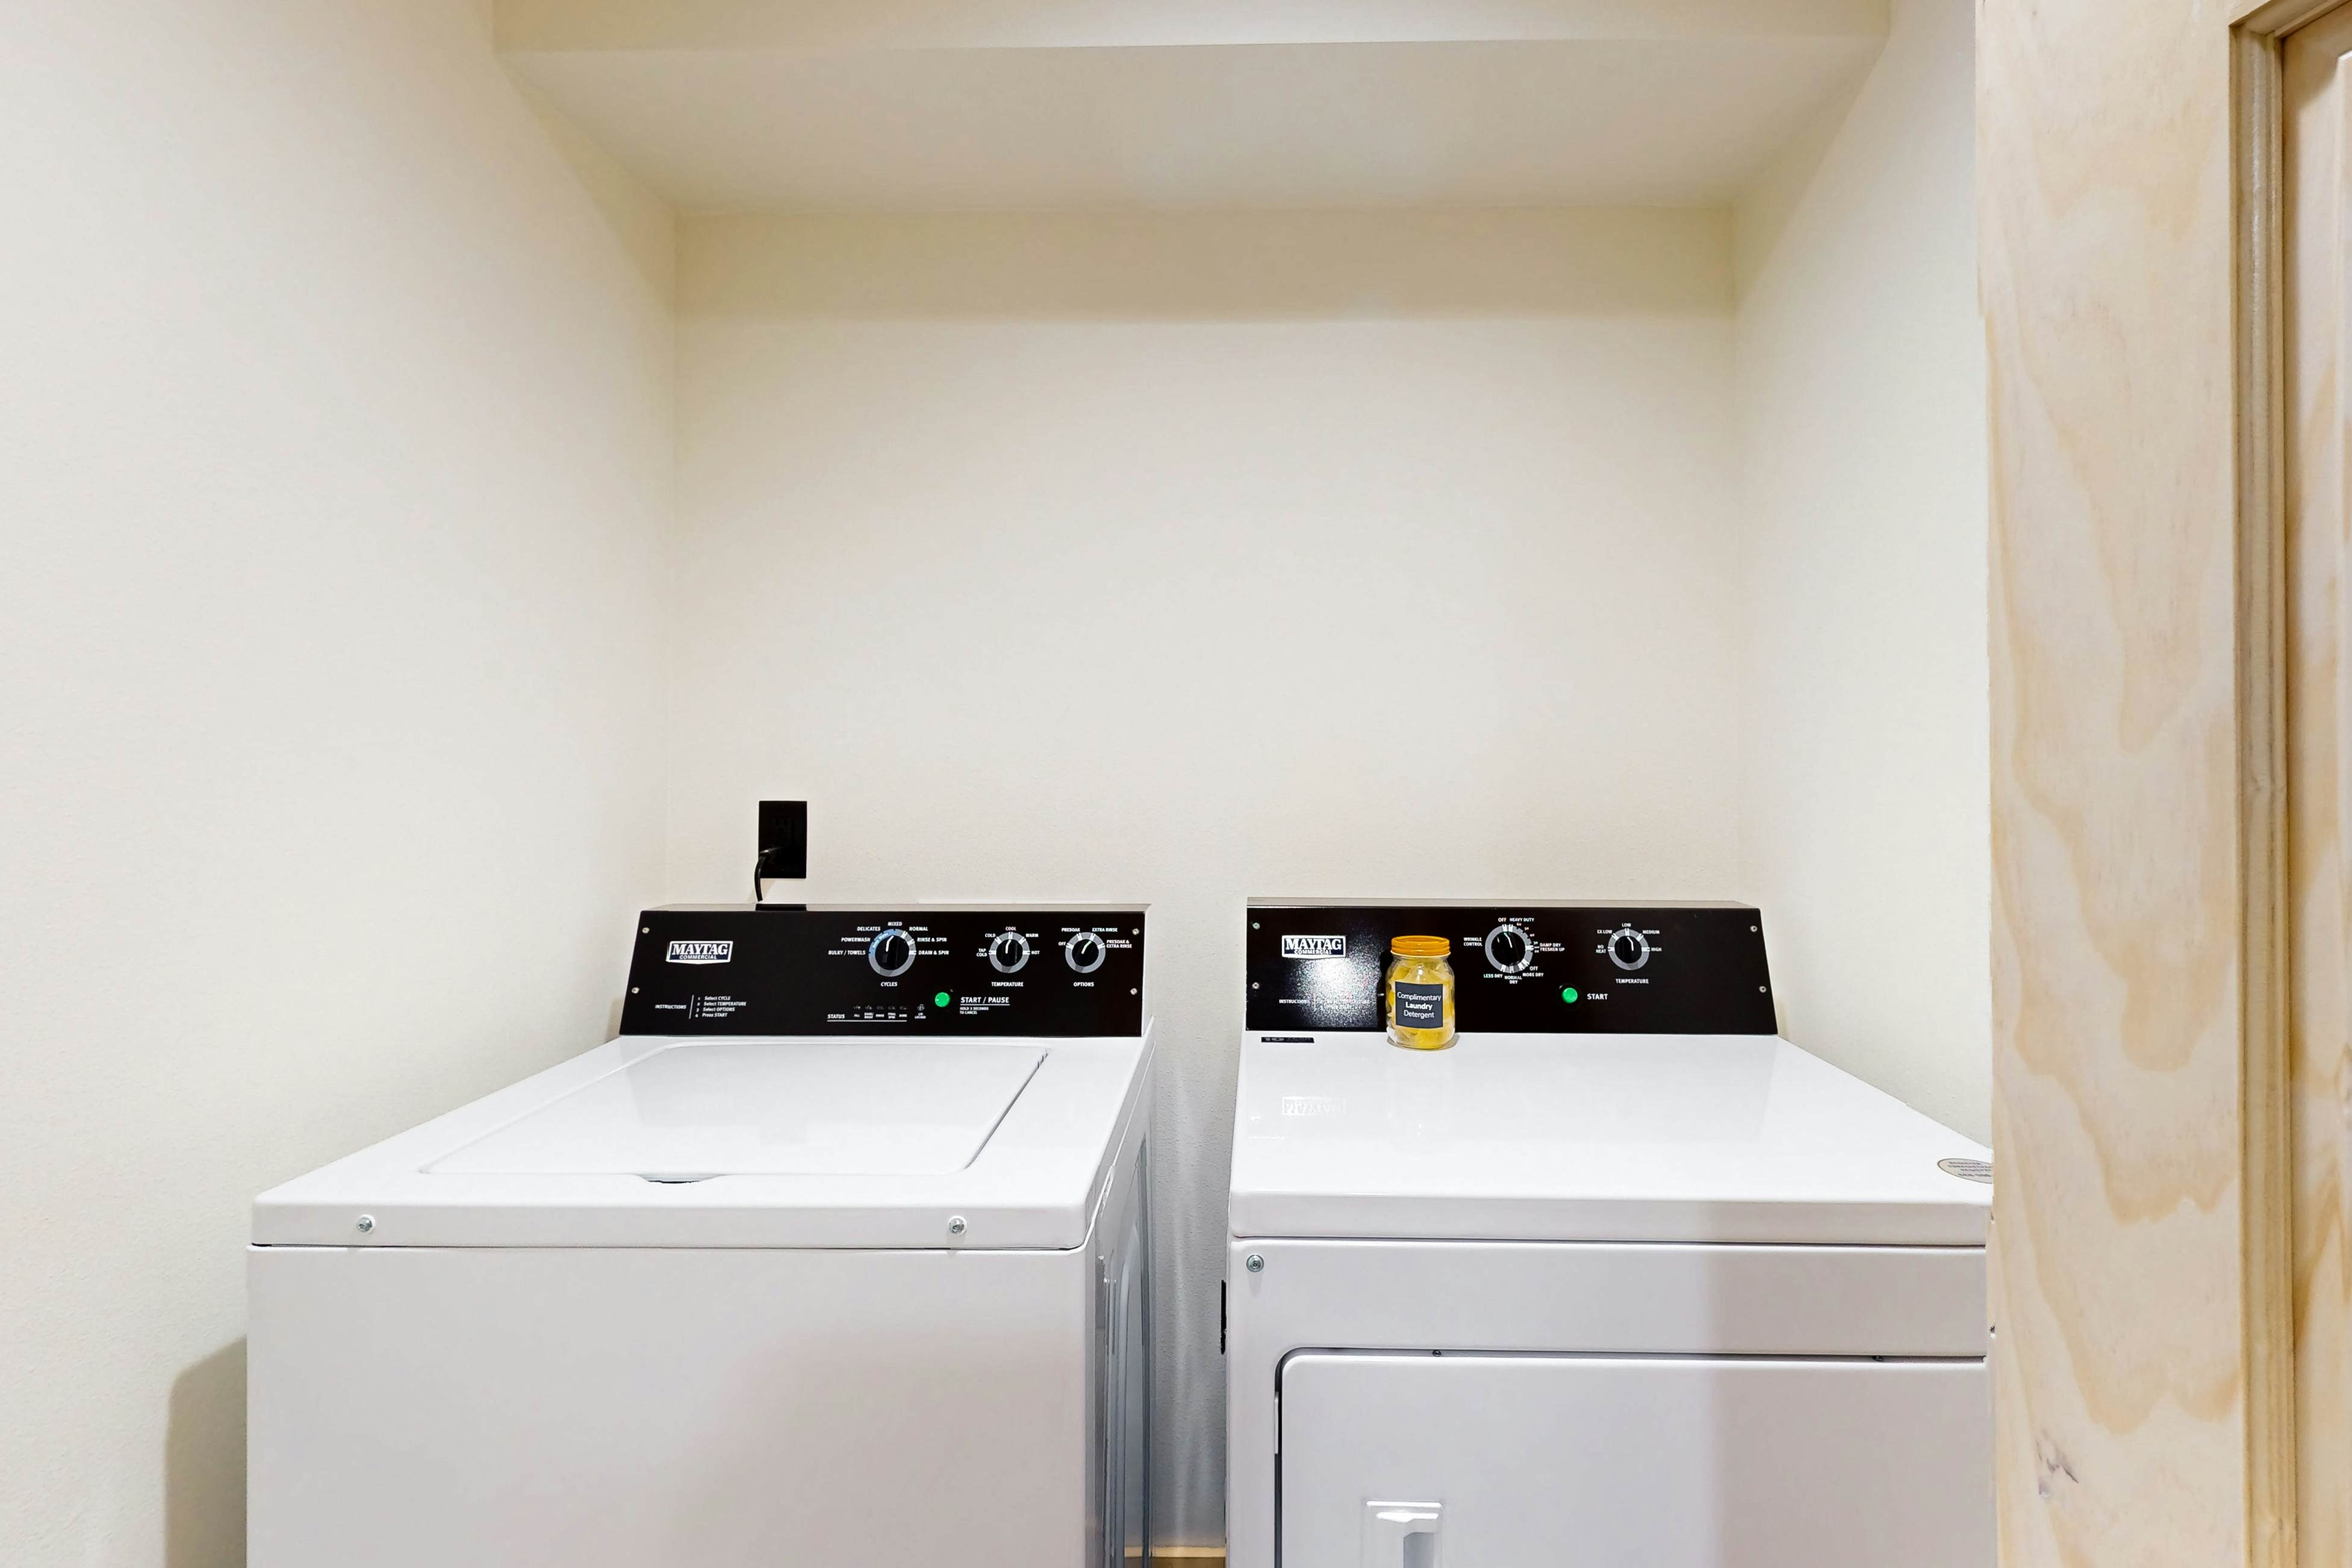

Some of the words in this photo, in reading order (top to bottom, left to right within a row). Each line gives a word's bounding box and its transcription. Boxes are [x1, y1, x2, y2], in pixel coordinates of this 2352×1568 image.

[1286, 938, 1342, 950] MAYTAG
[672, 944, 728, 955] MAYTAG
[1397, 992, 1442, 1001] Complimentary
[1405, 1001, 1433, 1010] Laundry
[1404, 1009, 1434, 1019] Detergent
